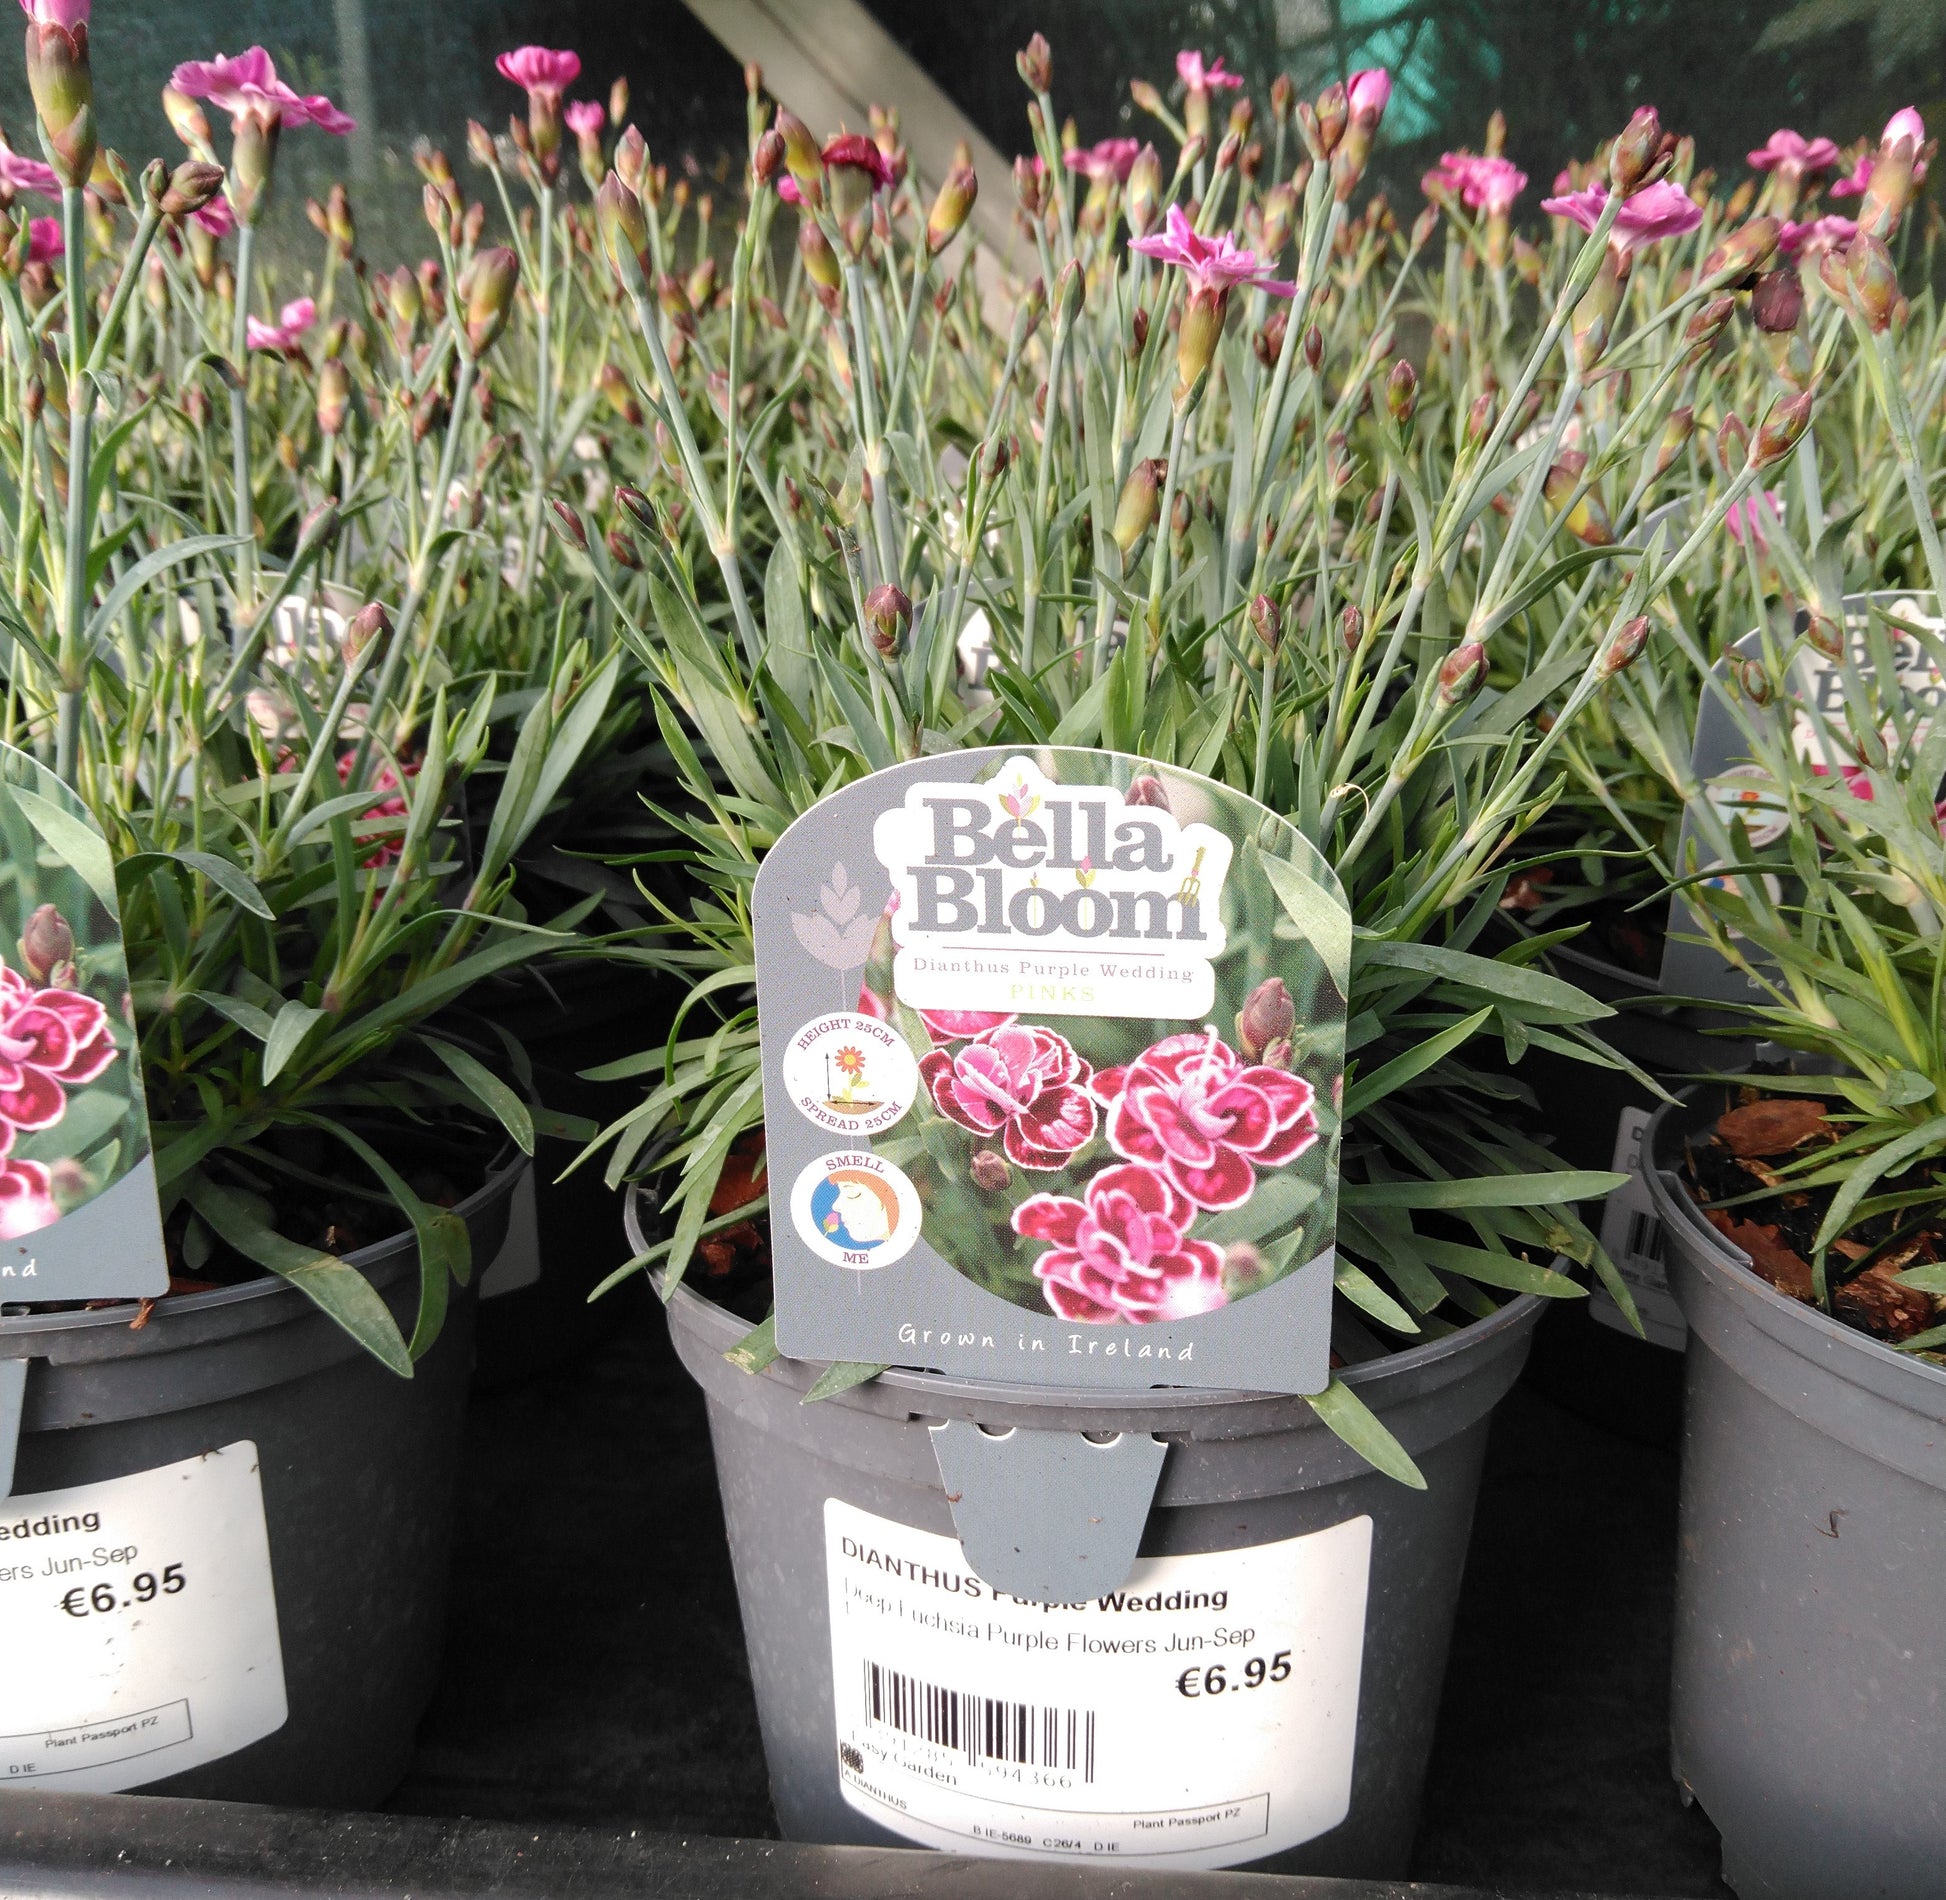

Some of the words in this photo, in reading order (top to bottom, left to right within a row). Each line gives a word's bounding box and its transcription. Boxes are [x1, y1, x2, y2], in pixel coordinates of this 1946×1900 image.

[922, 797, 1173, 872] Bella
[907, 866, 1207, 941] Bloom
[913, 957, 1009, 974] Dianthus
[1019, 961, 1090, 979] Purple
[1100, 963, 1194, 983] Wedding
[1010, 984, 1095, 1002] PINKS
[797, 1018, 851, 1051] HEIGHT
[855, 1021, 896, 1048] 25CM
[801, 1096, 859, 1130] SPREAD
[865, 1101, 903, 1129] 25CM
[825, 1155, 885, 1174] SMELL
[842, 1252, 869, 1264] ME
[898, 1323, 995, 1348] Grown
[1018, 1333, 1045, 1351] in
[1068, 1334, 1194, 1361] Ireland
[42, 1545, 138, 1577] Jun-Sep
[842, 1536, 981, 1598] DIANTHUS
[1098, 1589, 1228, 1613] Wedding
[60, 1562, 186, 1618] €6.95
[988, 1622, 1058, 1651] Purple
[1067, 1632, 1157, 1653] Flowers
[1164, 1627, 1256, 1652] Jun-Sep
[1175, 1649, 1292, 1697] €6.95
[45, 1736, 77, 1748] Plant
[81, 1723, 138, 1743] Passport
[142, 1715, 159, 1729] PZ
[9, 1764, 20, 1774] D
[23, 1763, 37, 1773] IE
[854, 1775, 907, 1810] DIANTHUS
[1133, 1819, 1164, 1829] Plant
[1169, 1811, 1221, 1827] Passport
[1225, 1807, 1241, 1819] PZ
[973, 1824, 981, 1835] B
[1094, 1842, 1103, 1851] D
